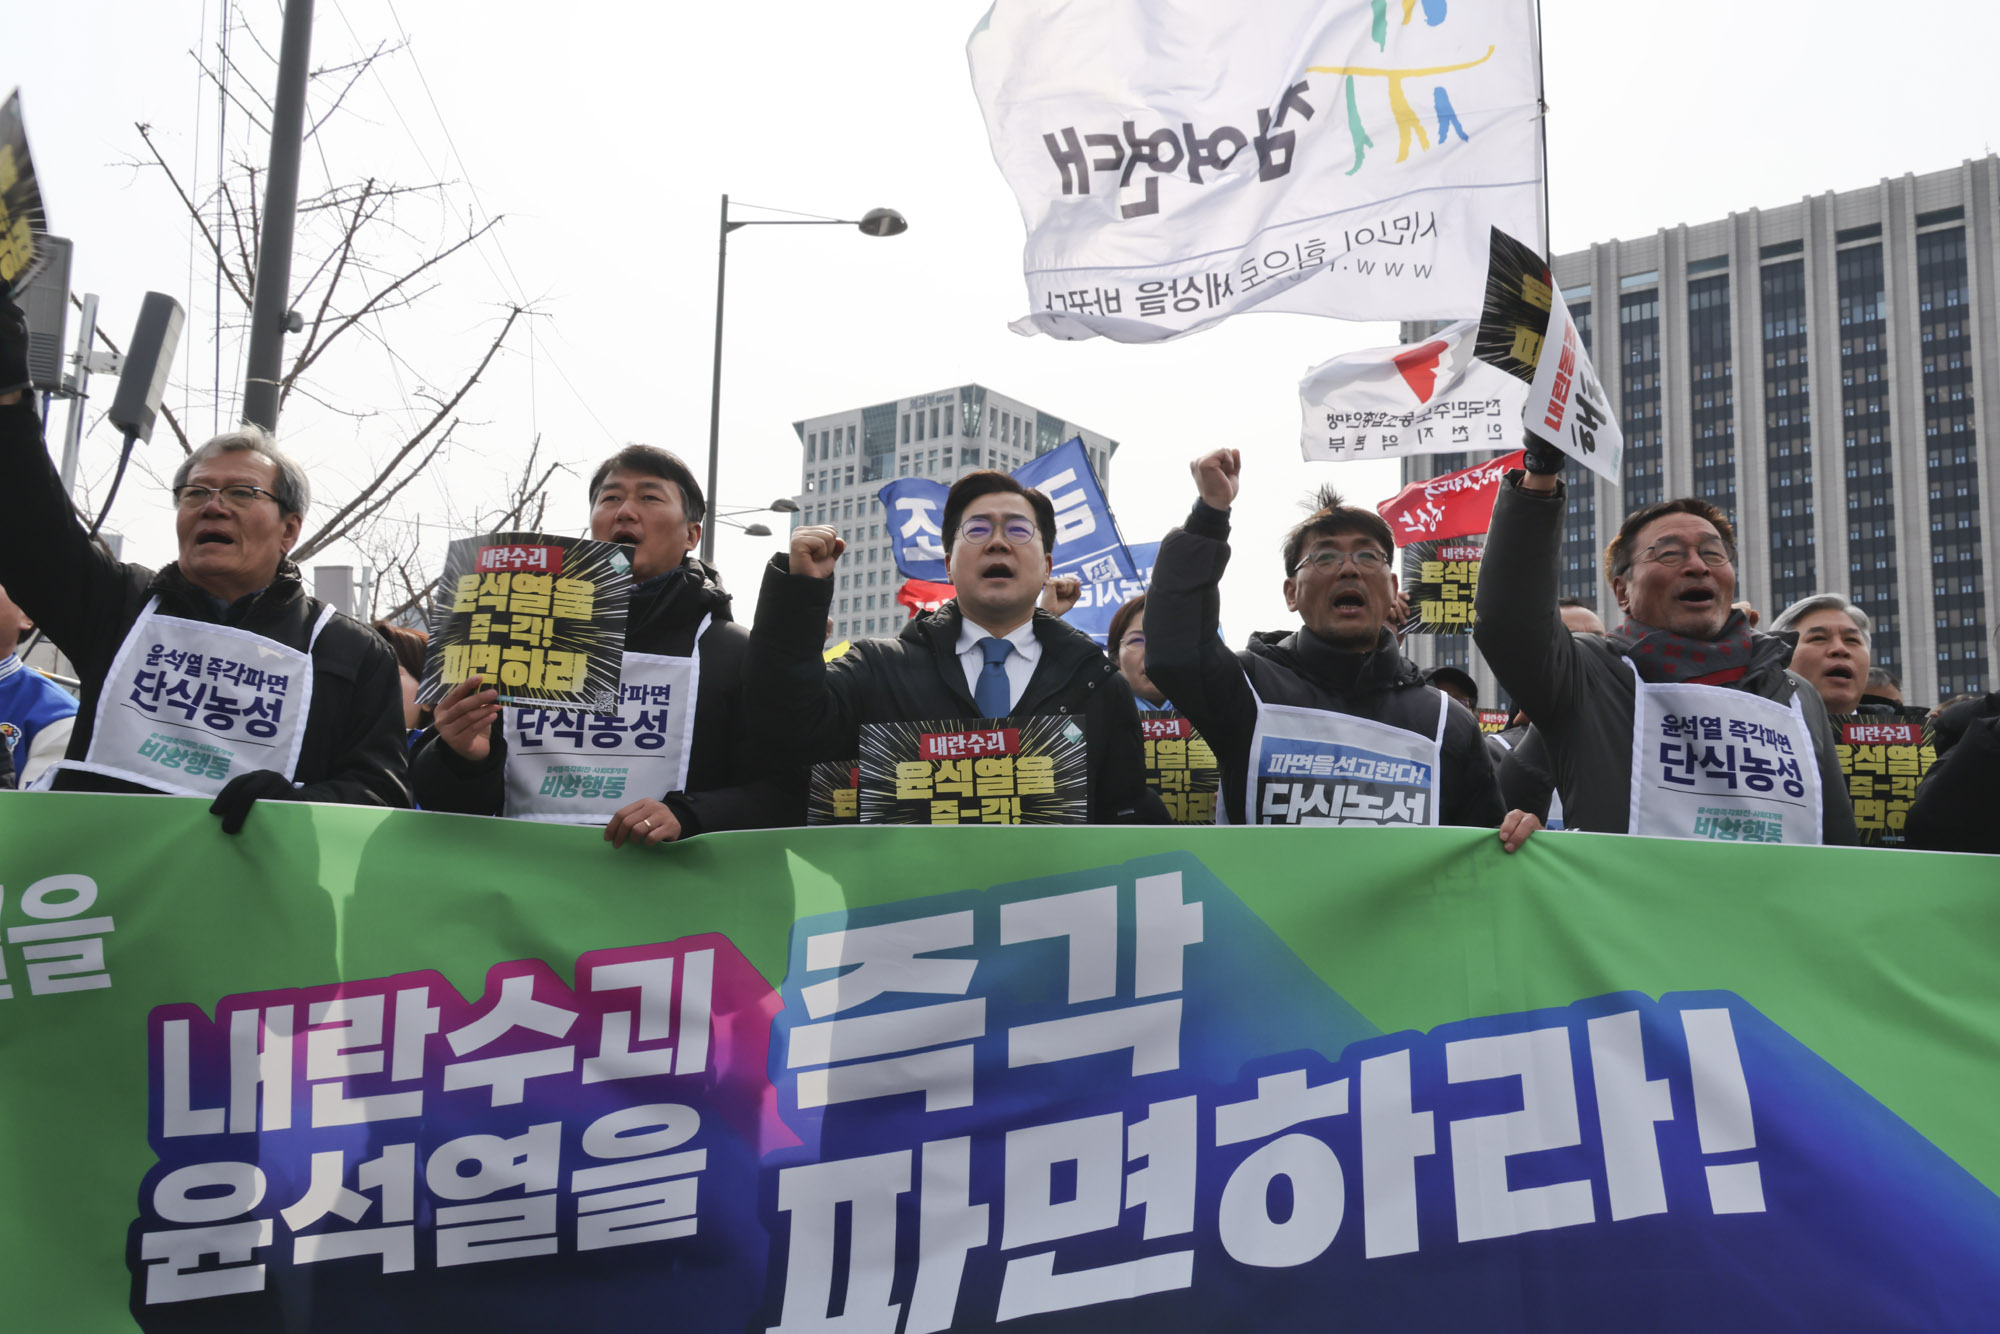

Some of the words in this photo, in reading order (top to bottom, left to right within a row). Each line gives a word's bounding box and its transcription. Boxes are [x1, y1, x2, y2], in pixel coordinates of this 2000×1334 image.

[481, 547, 547, 568] 내란수괴
[452, 573, 595, 621] 윤석열을
[146, 644, 204, 678] 윤석열
[206, 656, 289, 697] 즉각파면
[440, 644, 588, 692] 파면하라
[129, 669, 283, 738] 단식농성
[516, 708, 668, 750] 단식농성
[929, 731, 1006, 756] 내란수괴
[1661, 714, 1722, 740] 윤석열
[1729, 719, 1795, 755] 즉각파면
[1850, 725, 1911, 742] 내란수괴
[137, 738, 231, 780] 비상행동
[896, 756, 1055, 799] 윤석열을
[1660, 742, 1804, 798] 단식농성
[539, 773, 626, 799] 비상행동
[1693, 816, 1783, 843] 비상행동
[786, 871, 1203, 1113] 즉각
[162, 948, 715, 1138] 내란수괴
[765, 1007, 1767, 1334] 파면하라!
[141, 1103, 708, 1304] 윤석열을
